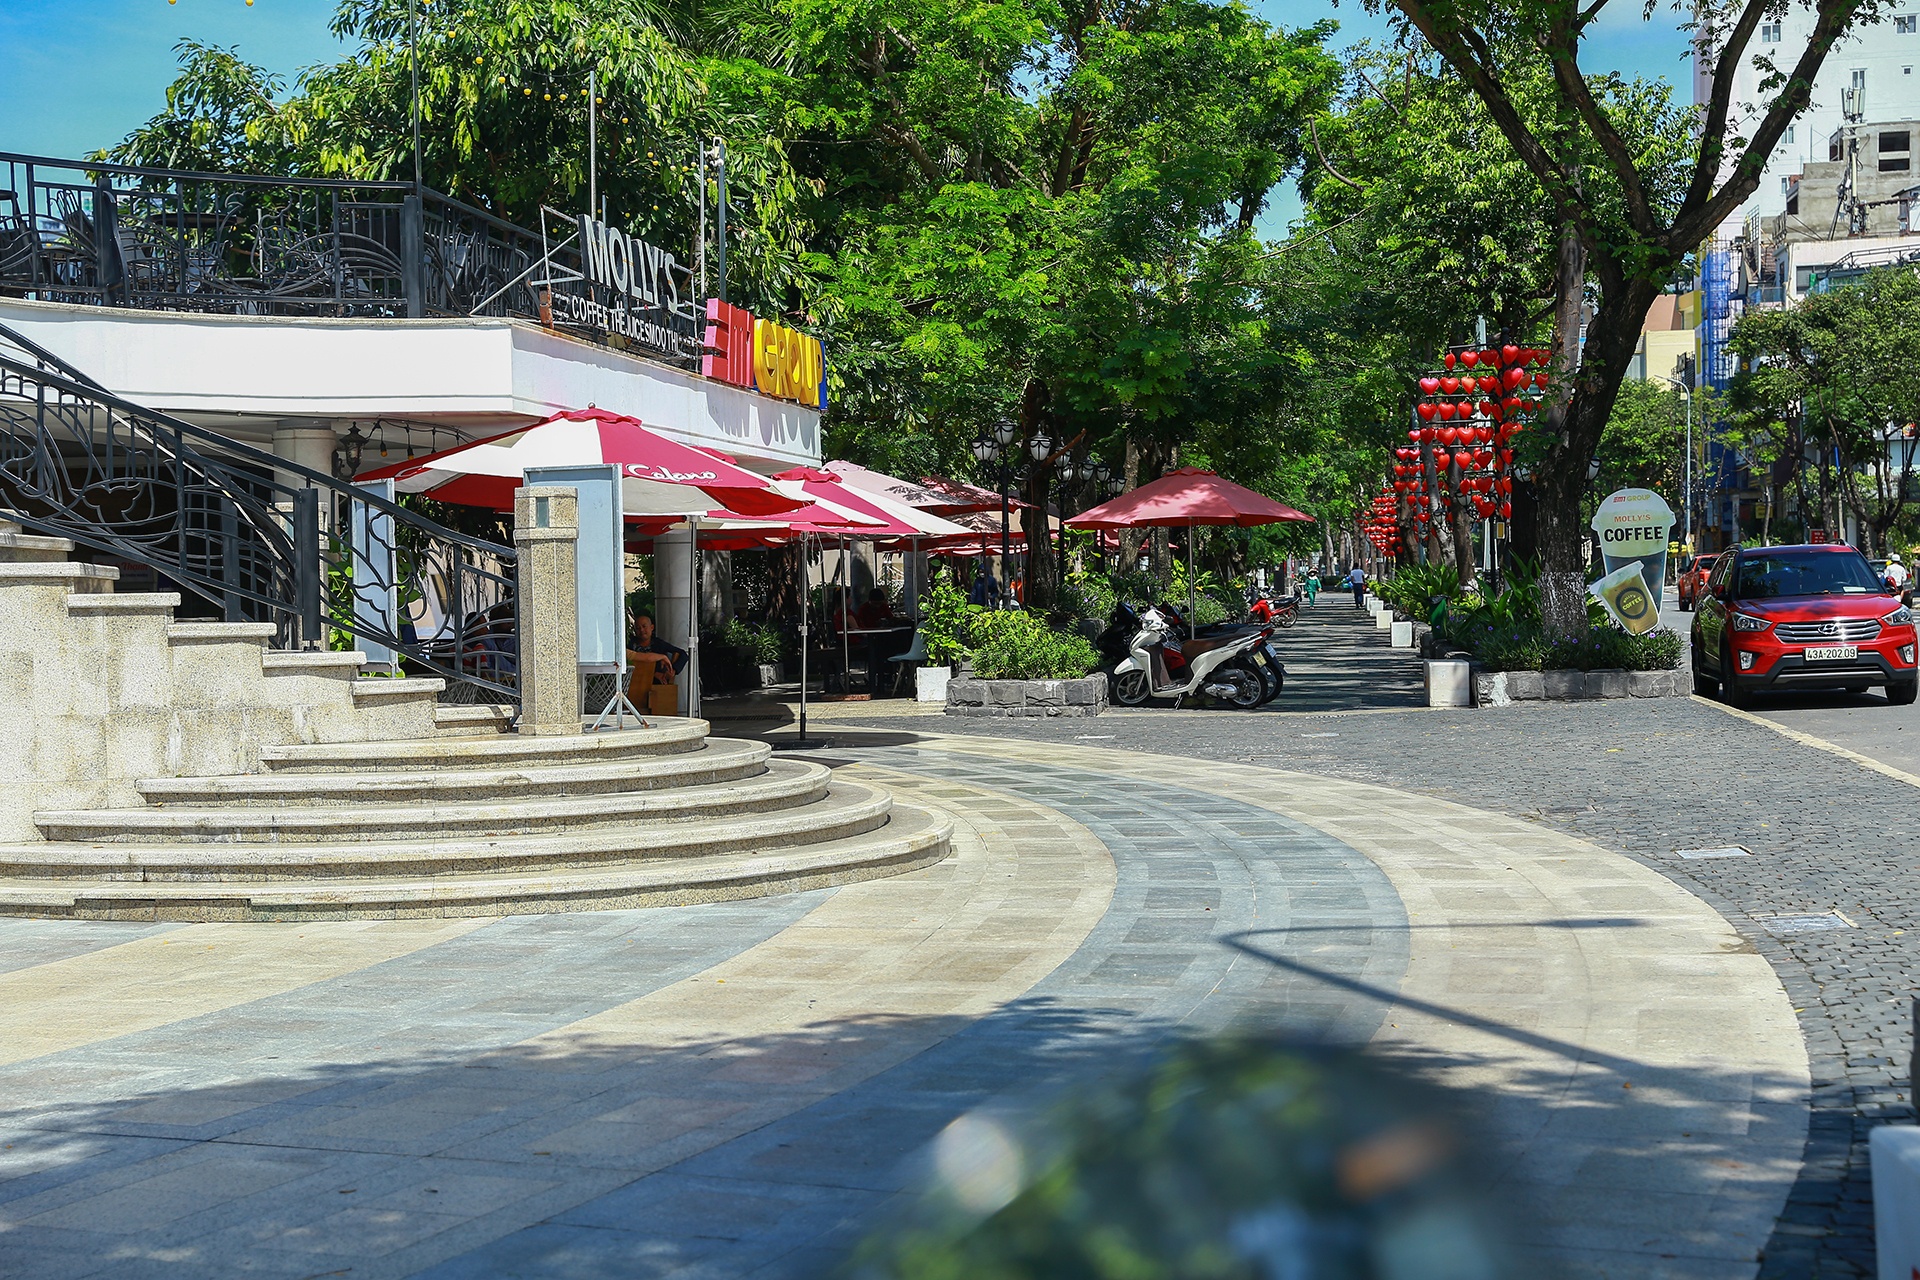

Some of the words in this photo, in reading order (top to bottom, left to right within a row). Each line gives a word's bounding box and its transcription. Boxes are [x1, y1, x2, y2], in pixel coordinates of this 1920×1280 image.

[579, 214, 679, 314] MOLLY'S
[571, 294, 610, 332] COFFEE
[754, 318, 823, 406] GROUP
[1626, 494, 1651, 502] GROUP
[1613, 514, 1651, 523] MOLLY'S
[1603, 526, 1664, 543] COFFEE
[1622, 596, 1643, 611] COFFEE
